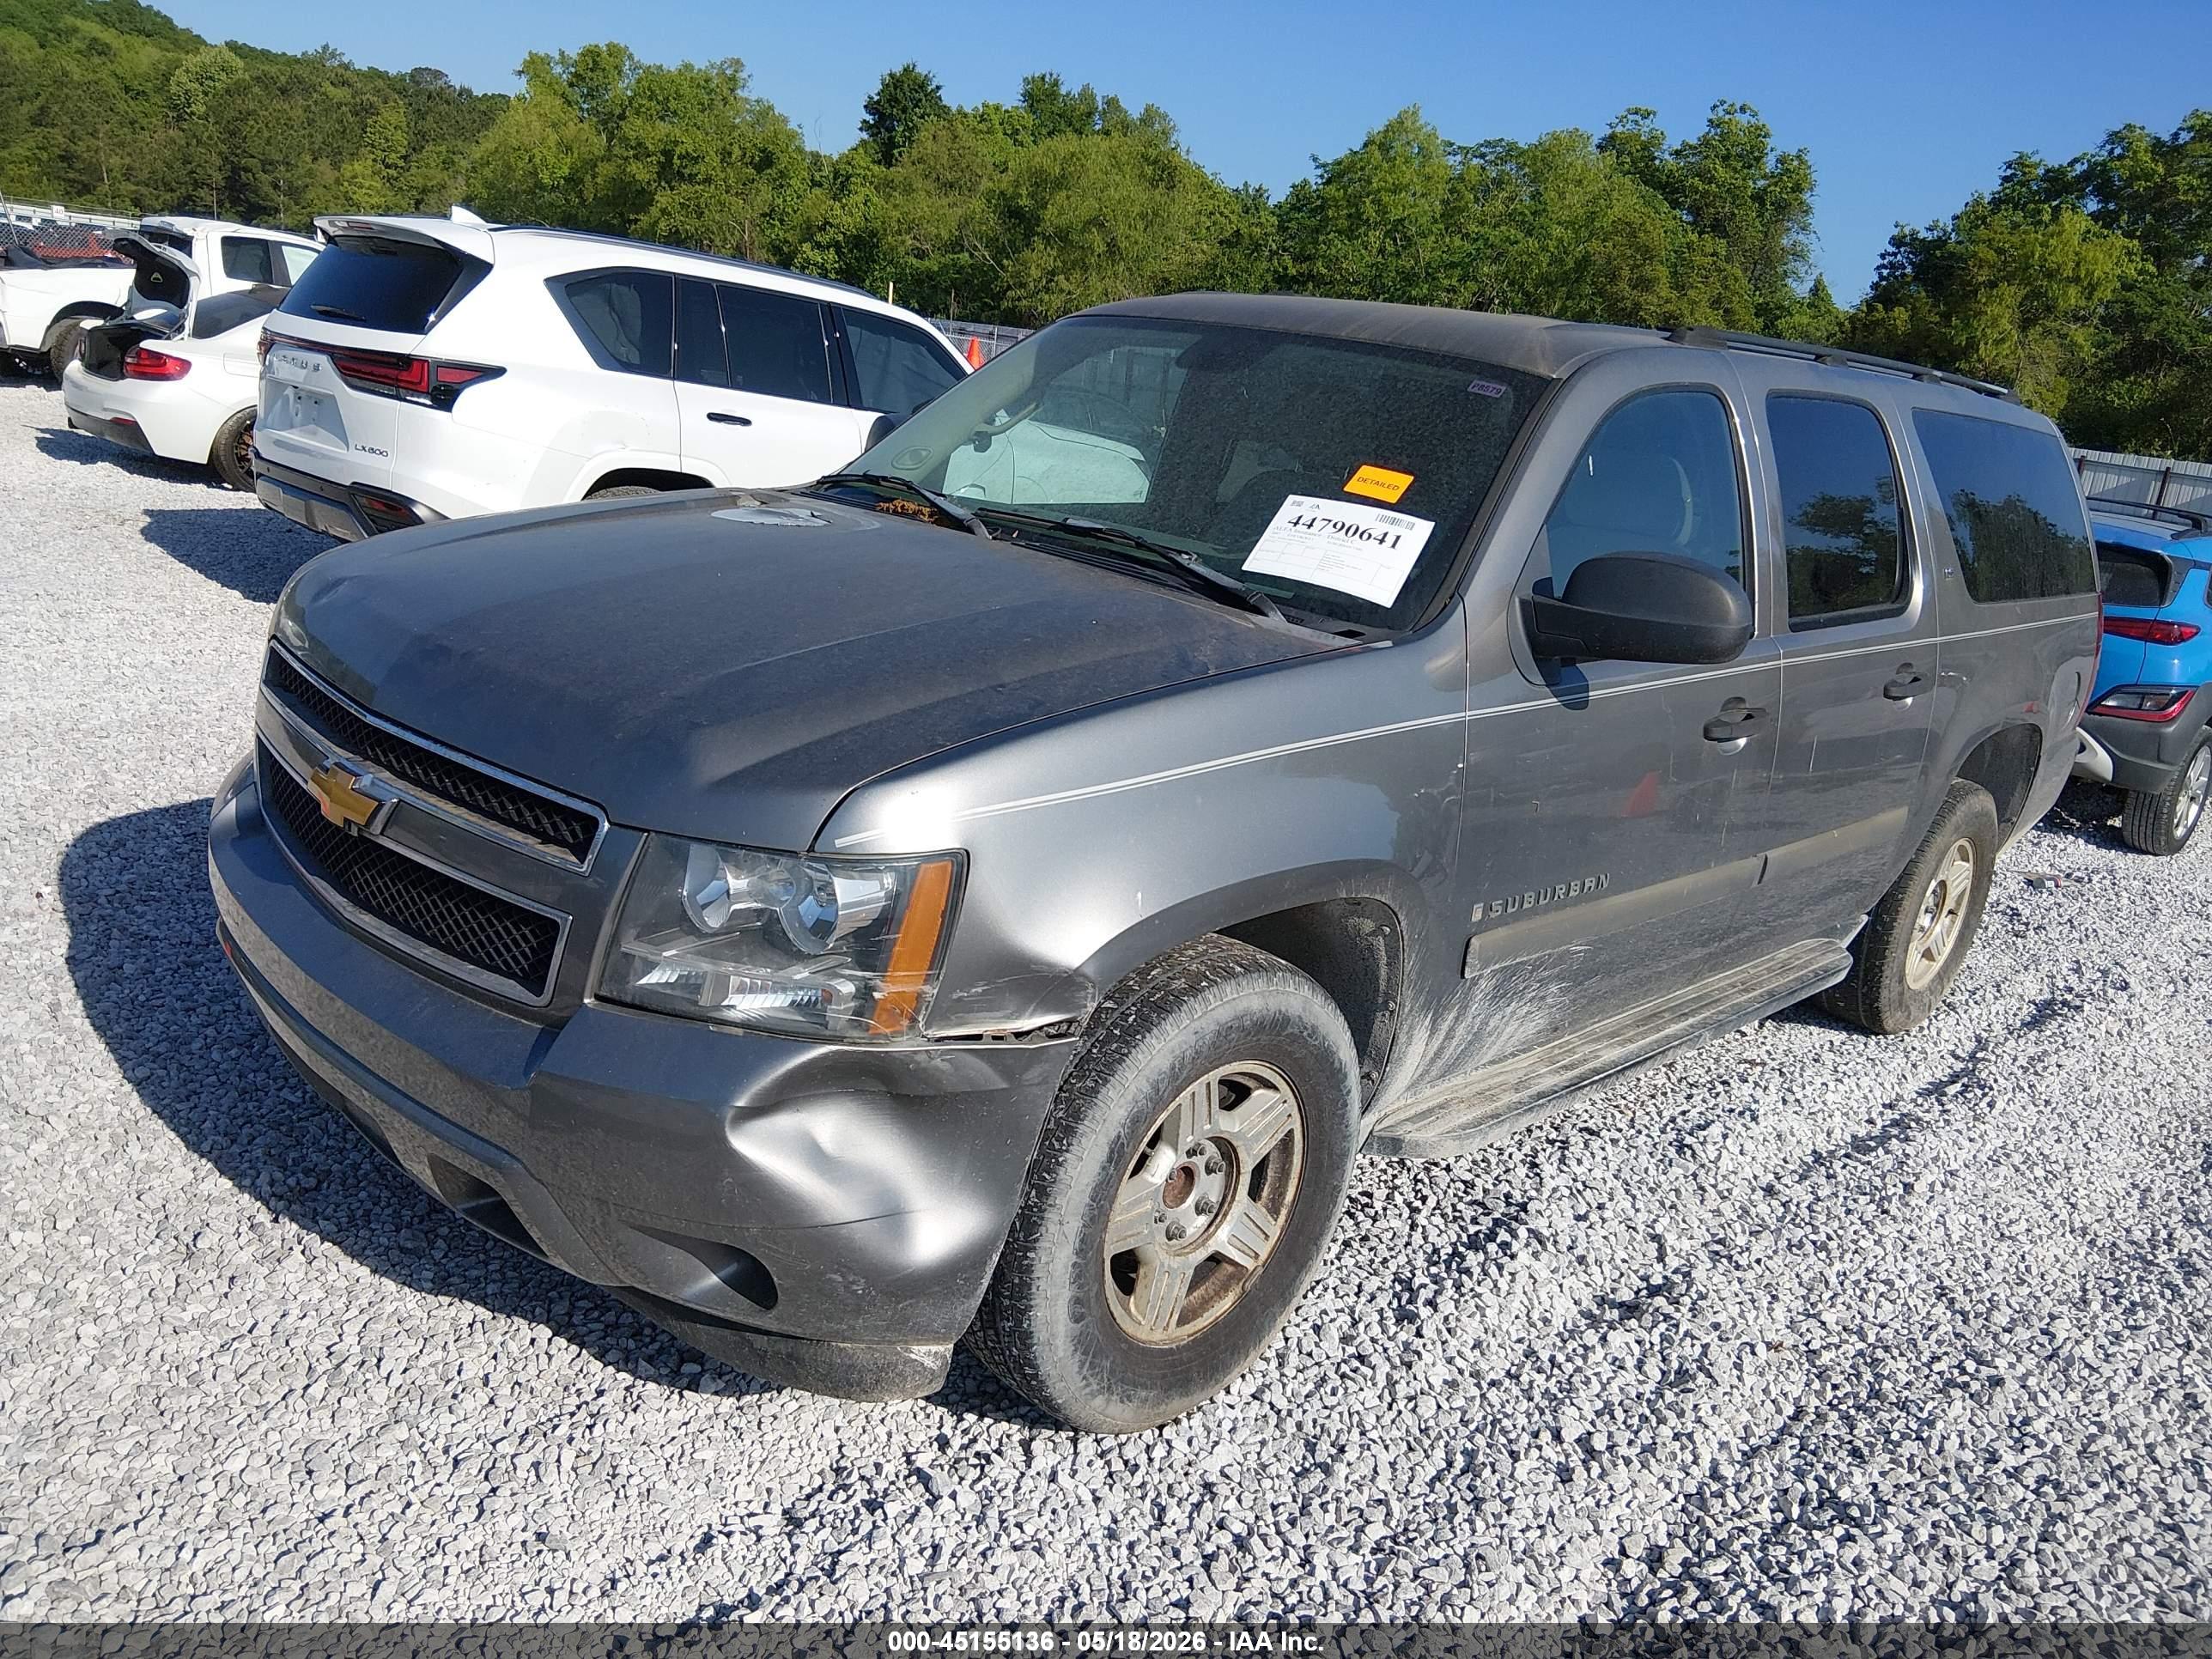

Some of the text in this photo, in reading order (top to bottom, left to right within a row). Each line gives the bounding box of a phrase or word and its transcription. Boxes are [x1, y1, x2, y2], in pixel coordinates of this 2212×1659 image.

[1357, 476, 1400, 491] DETAILED
[1287, 514, 1402, 550] 44790641
[1489, 873, 1610, 917] SUBURBAN
